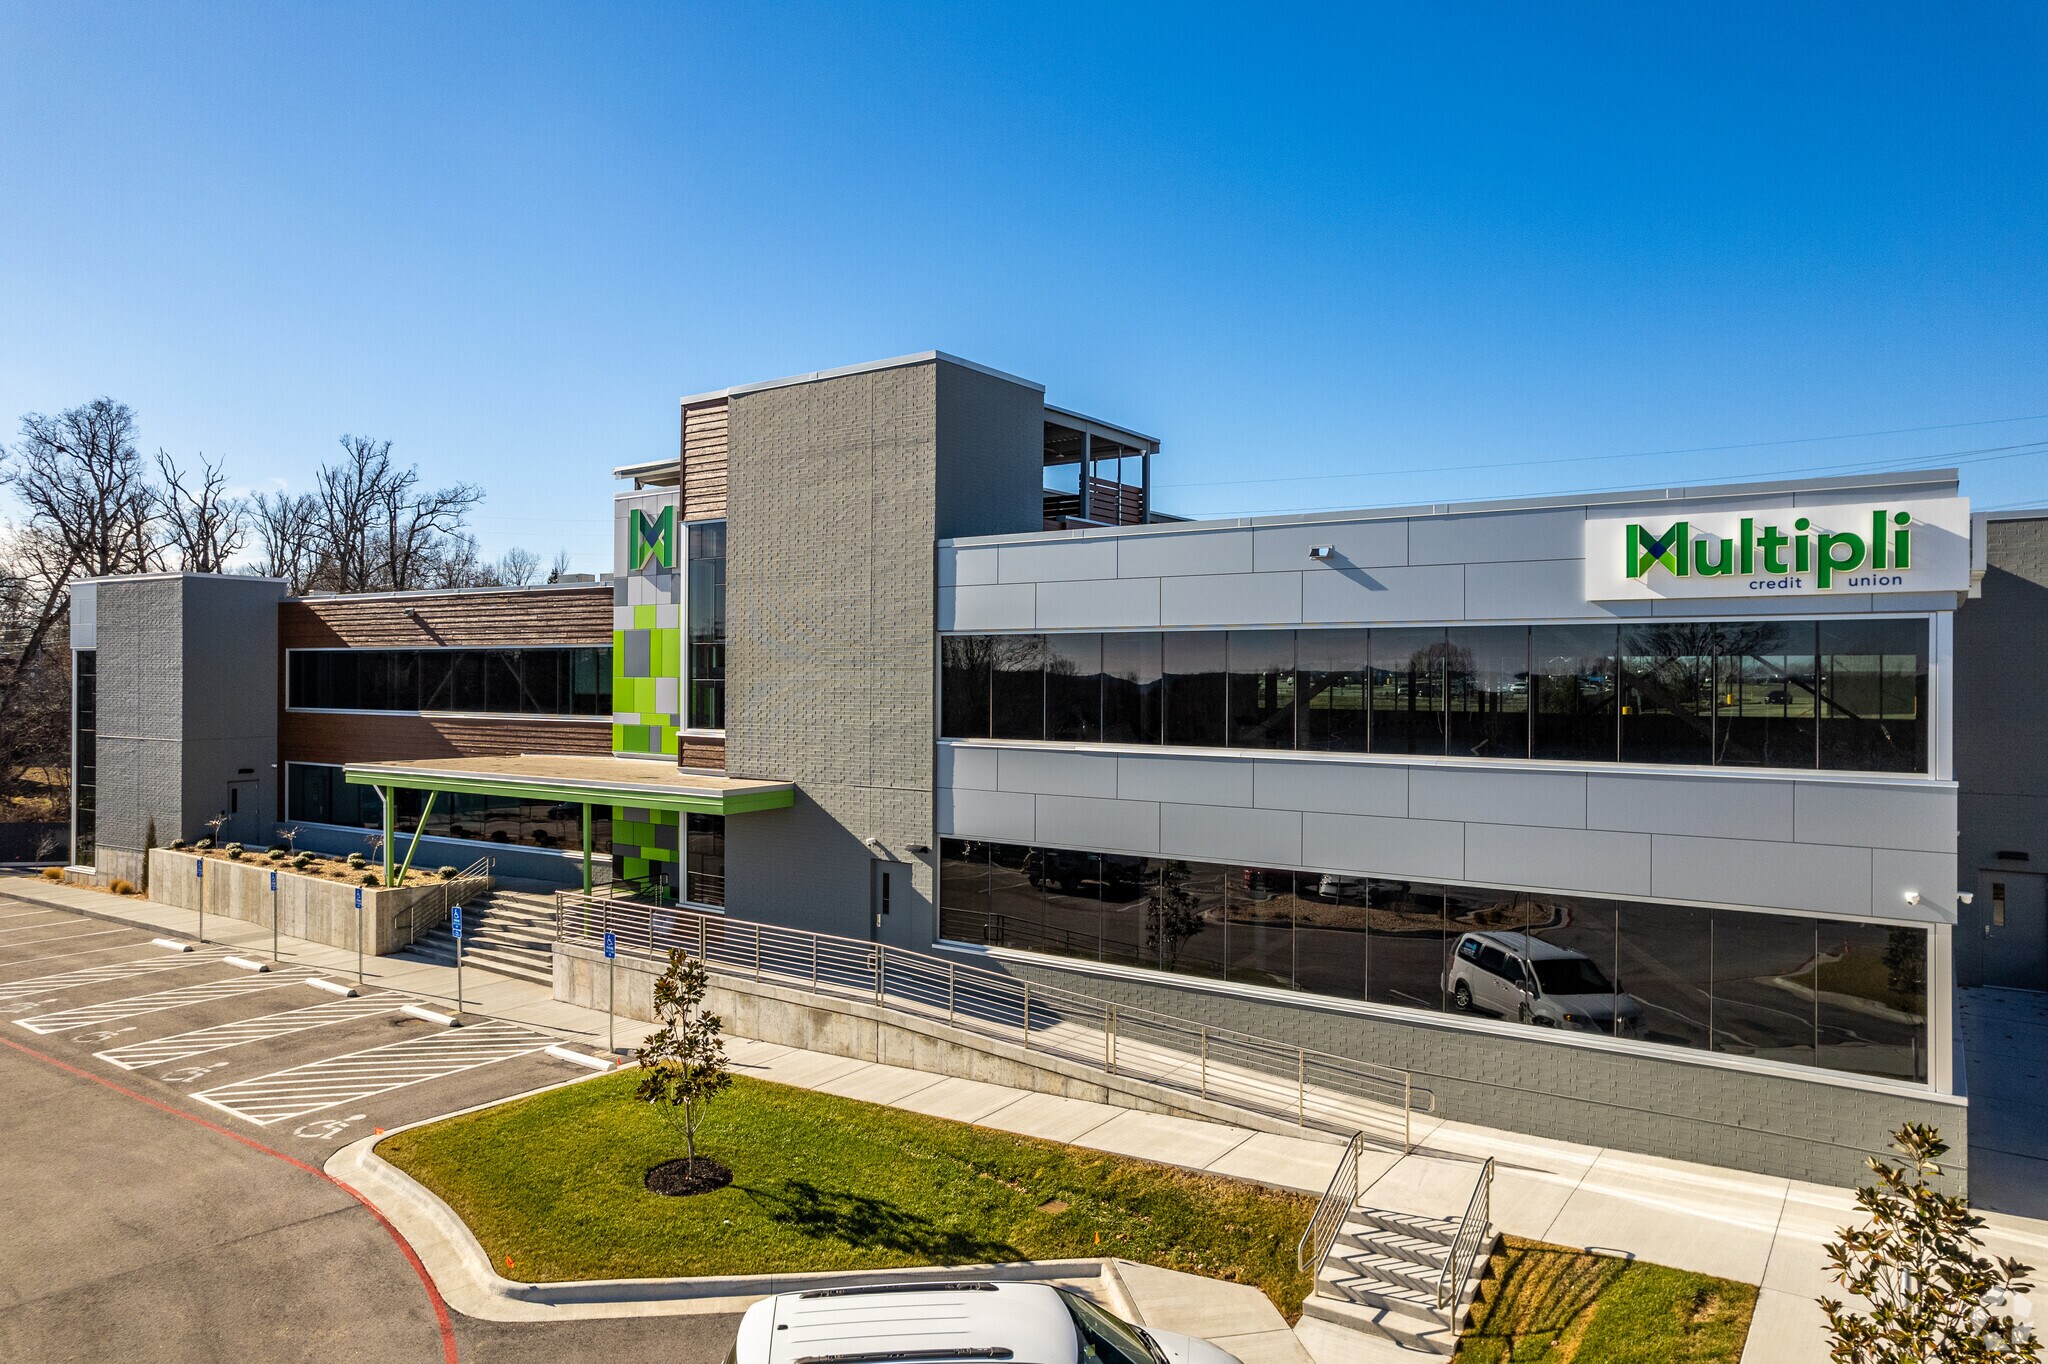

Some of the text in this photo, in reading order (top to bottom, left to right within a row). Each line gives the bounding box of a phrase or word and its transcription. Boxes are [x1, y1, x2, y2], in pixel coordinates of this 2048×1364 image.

[1626, 510, 1913, 590] Multipli
[1749, 573, 1903, 590] credit union
